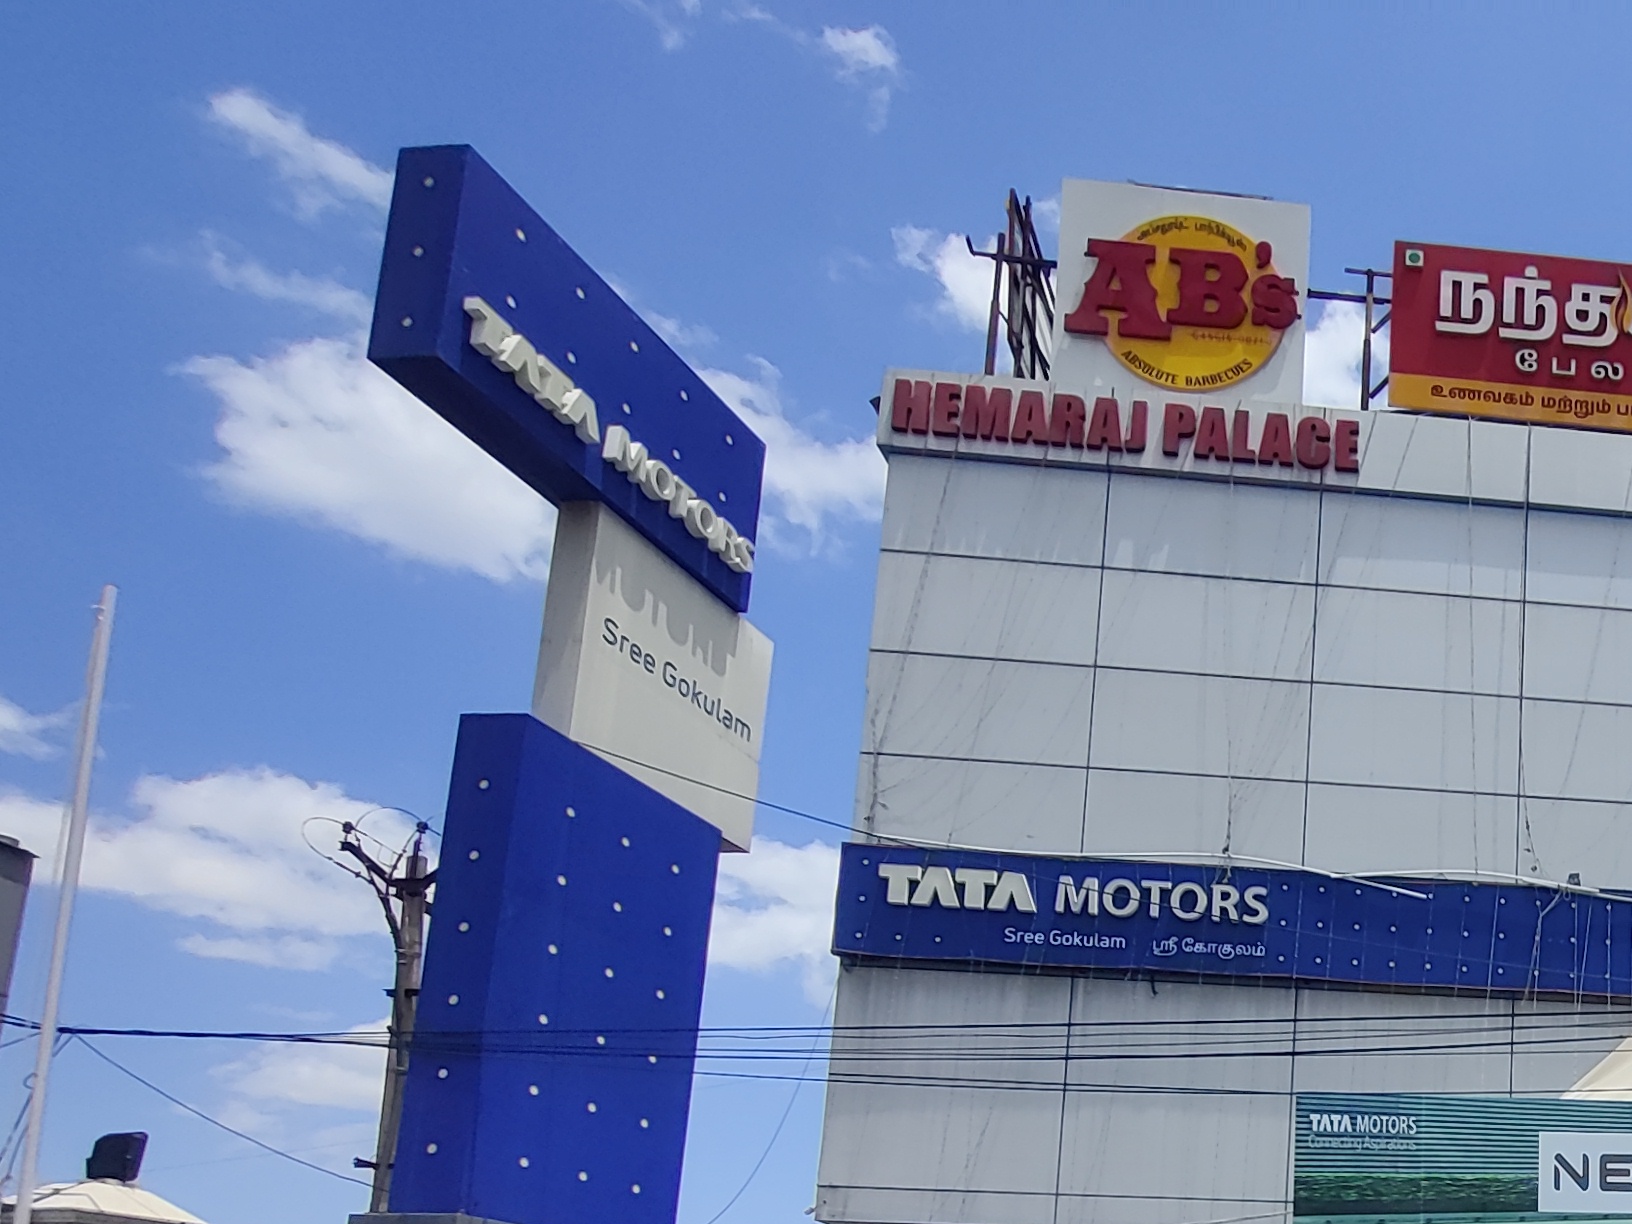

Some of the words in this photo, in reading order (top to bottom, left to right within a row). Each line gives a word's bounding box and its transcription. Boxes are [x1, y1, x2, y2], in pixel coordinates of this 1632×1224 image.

[1064, 237, 1299, 341] AB's
[1120, 349, 1178, 385] ABSOLUTE
[1185, 357, 1253, 387] BARBECUES
[891, 378, 1149, 453] HEMARAJ
[1162, 402, 1361, 473] PALACE
[1430, 383, 1535, 406] உணவகம்
[1541, 392, 1611, 420] மற்றும்
[463, 295, 601, 444] TATA
[603, 425, 755, 574] MOTORS
[602, 617, 657, 675] Sree
[661, 660, 752, 743] Gokulam
[878, 863, 1038, 914] TATA
[1054, 874, 1270, 924] MOTORS
[1003, 927, 1045, 945] Sree
[1049, 930, 1127, 950] Gokulam
[1151, 936, 1177, 957] ஸ்ரீ
[1181, 937, 1266, 958] கோகுலம்
[1309, 1113, 1352, 1132] TATA
[1356, 1114, 1417, 1135] MOTORS
